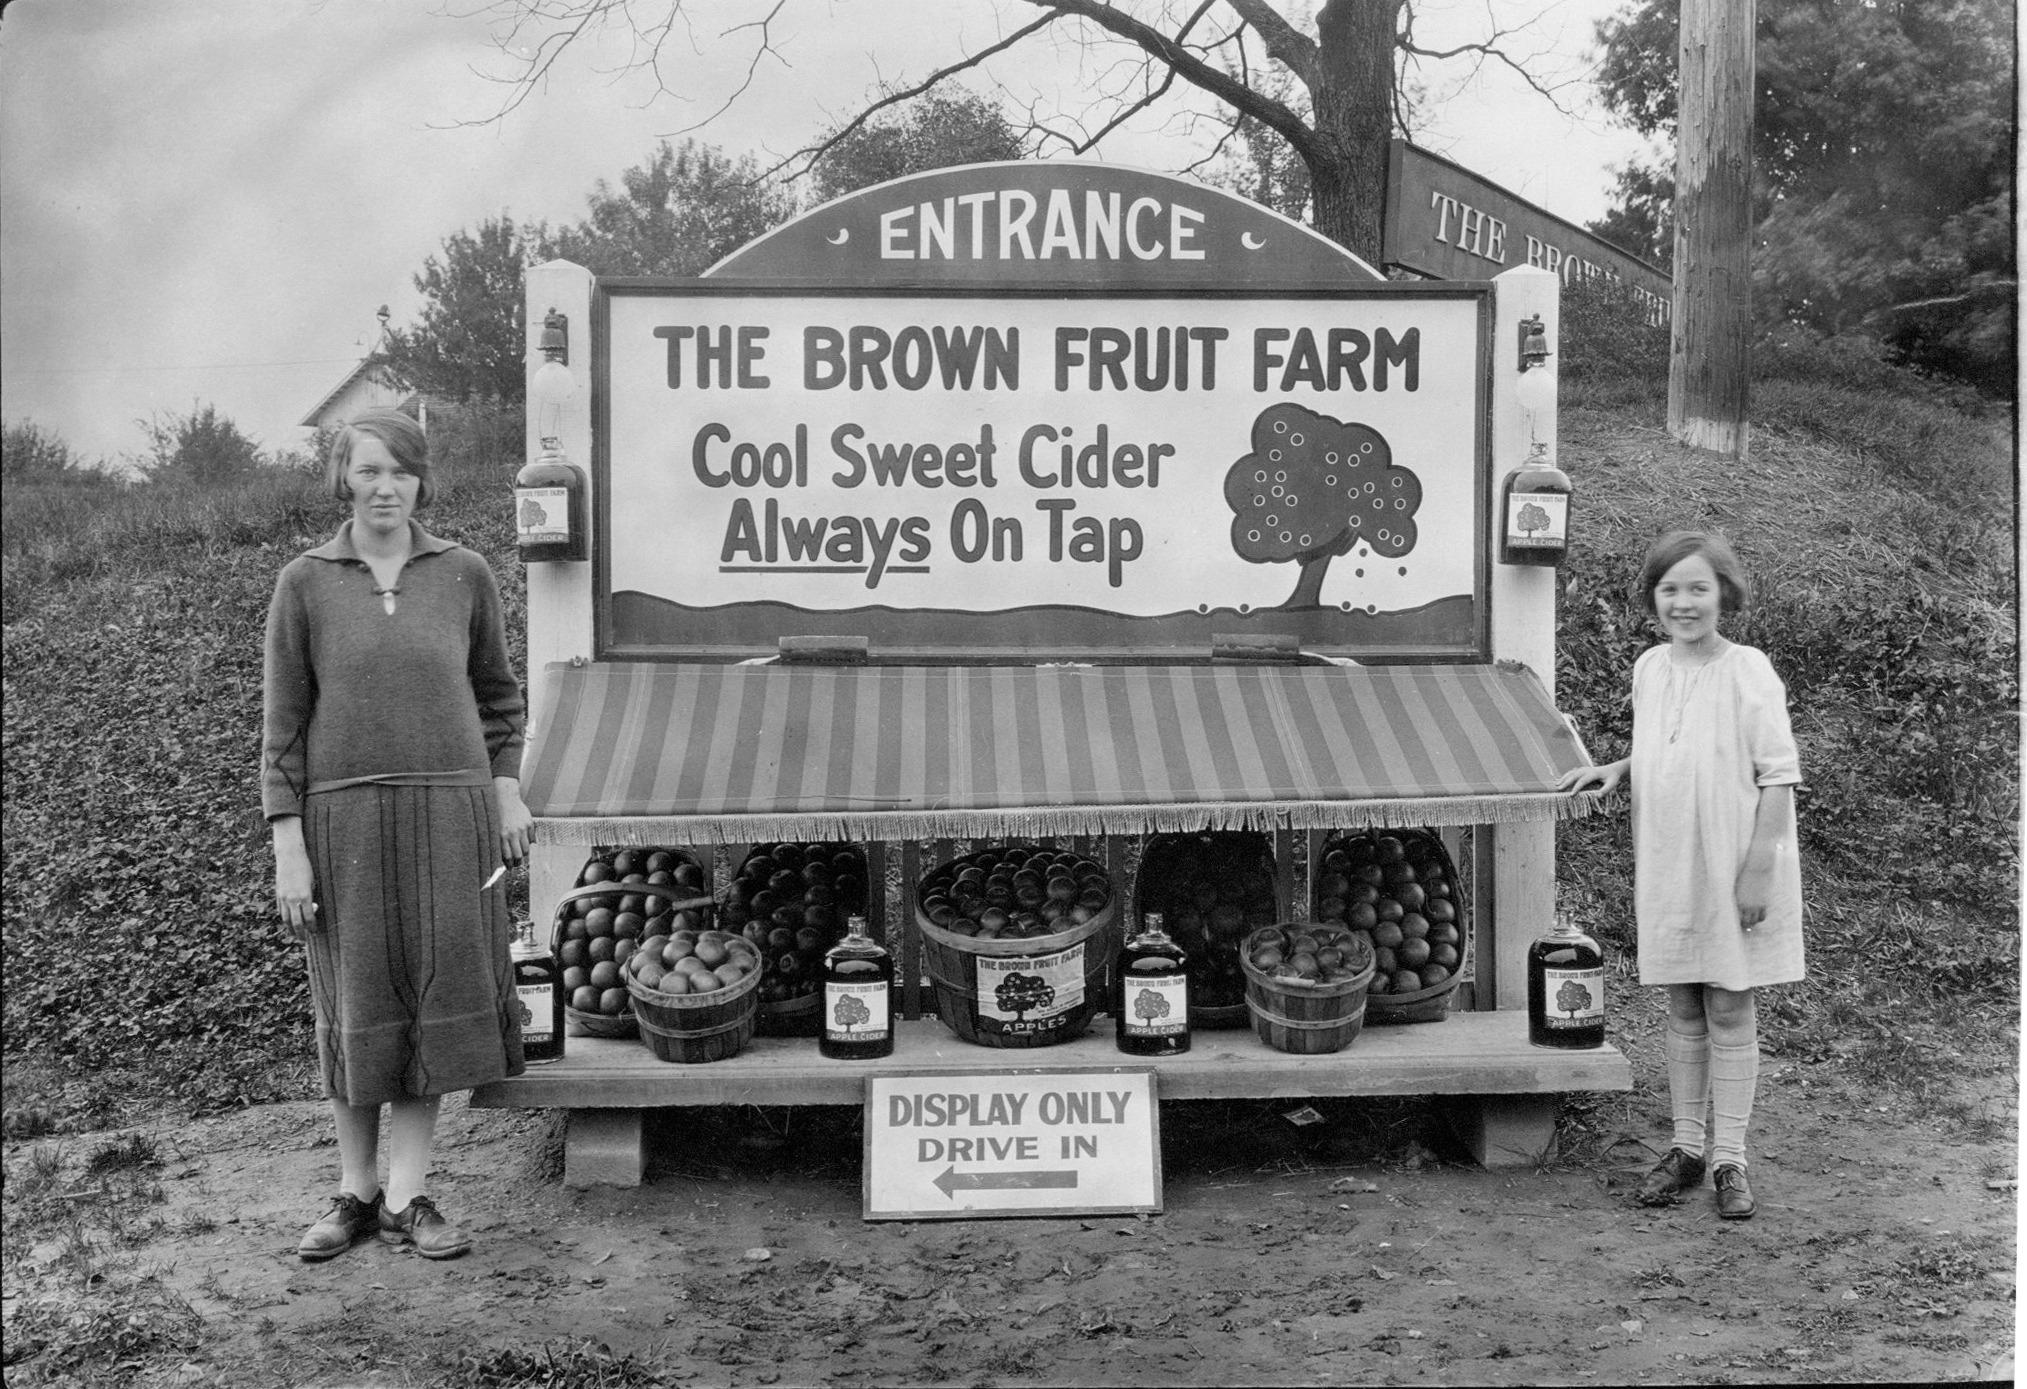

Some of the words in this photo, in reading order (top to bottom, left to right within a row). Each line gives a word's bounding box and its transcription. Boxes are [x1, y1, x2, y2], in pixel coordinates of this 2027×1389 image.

[880, 188, 1206, 261] ENTRANCE
[1431, 191, 1508, 264] THE
[654, 325, 771, 390] THE
[805, 326, 1020, 391] BROWN
[1056, 327, 1230, 392] FRUIT
[1254, 327, 1421, 393] FARM
[692, 423, 808, 489] Cool
[831, 424, 998, 489] Sweet
[1018, 425, 1176, 489] Cider
[719, 498, 933, 590] Always
[950, 498, 1023, 564] On
[1035, 499, 1144, 588] Tap
[978, 958, 997, 970] THE
[521, 1033, 550, 1042] CIDER
[830, 1032, 857, 1040] APPLE
[860, 1031, 885, 1040] CIDER
[1002, 1014, 1067, 1032] APPLES
[1130, 1026, 1158, 1035] APPLE
[889, 1093, 1029, 1127] DISPLAY
[1038, 1091, 1133, 1125] ONLY
[918, 1136, 1039, 1163] DRIVE
[1061, 1135, 1098, 1159] IN
